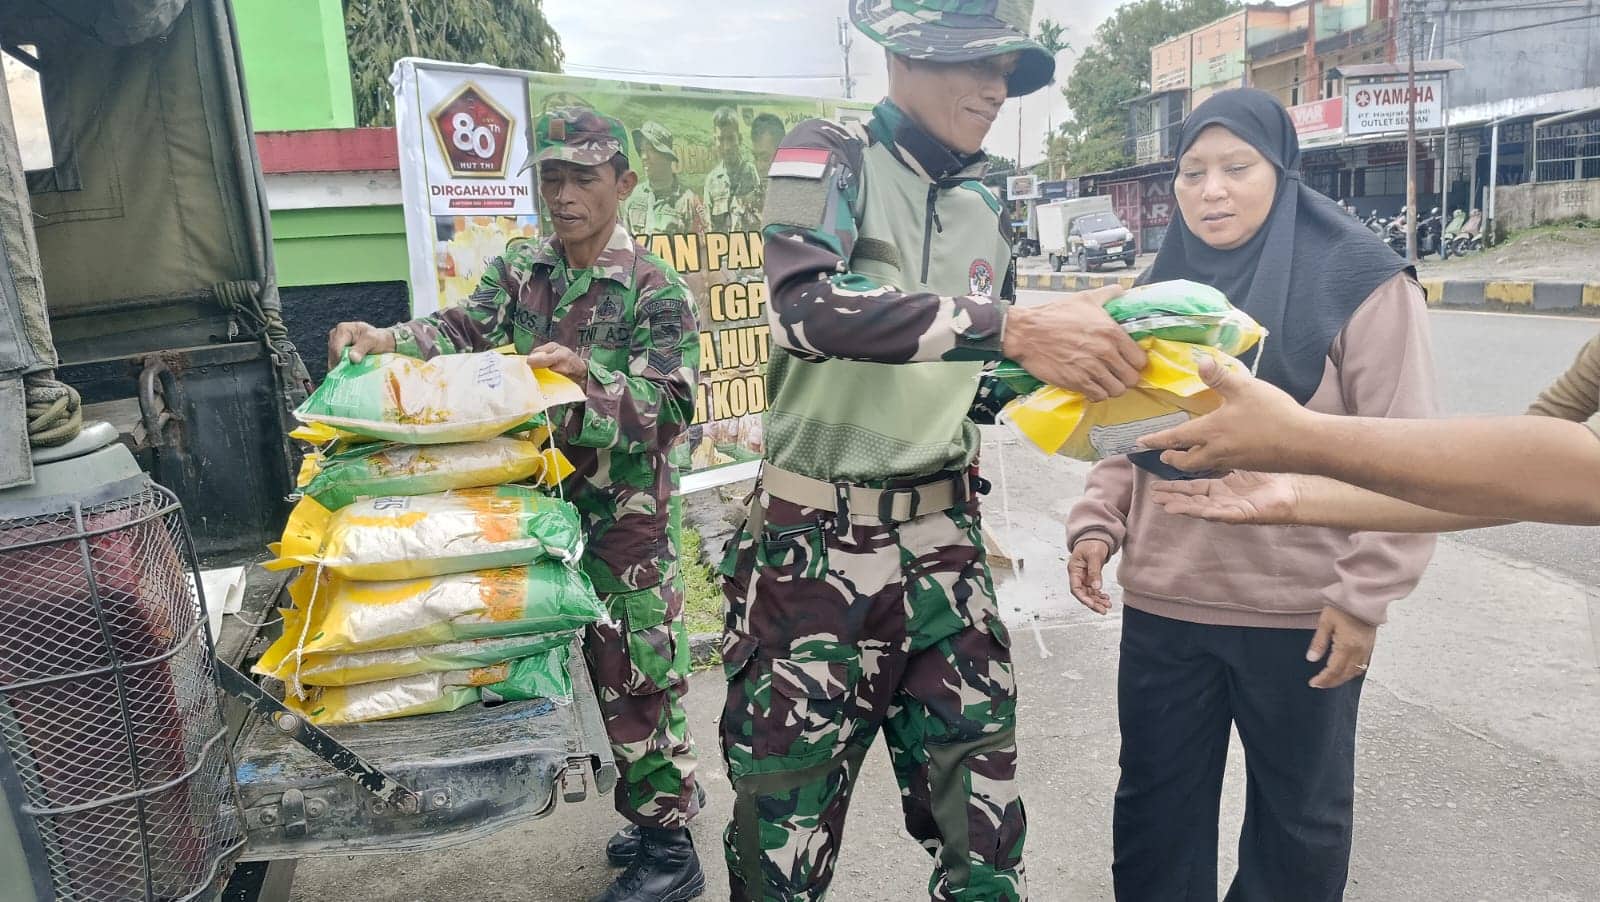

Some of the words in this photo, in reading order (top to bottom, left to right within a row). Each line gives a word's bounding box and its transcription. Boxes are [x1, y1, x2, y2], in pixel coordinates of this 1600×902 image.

[1373, 86, 1434, 106] YAMAHA
[1361, 118, 1394, 128] OUTLET
[452, 112, 495, 159] 80
[431, 185, 506, 196] DIRGAHAYU
[510, 186, 529, 196] TNI
[577, 326, 598, 341] TNI
[719, 323, 770, 370] HUT
